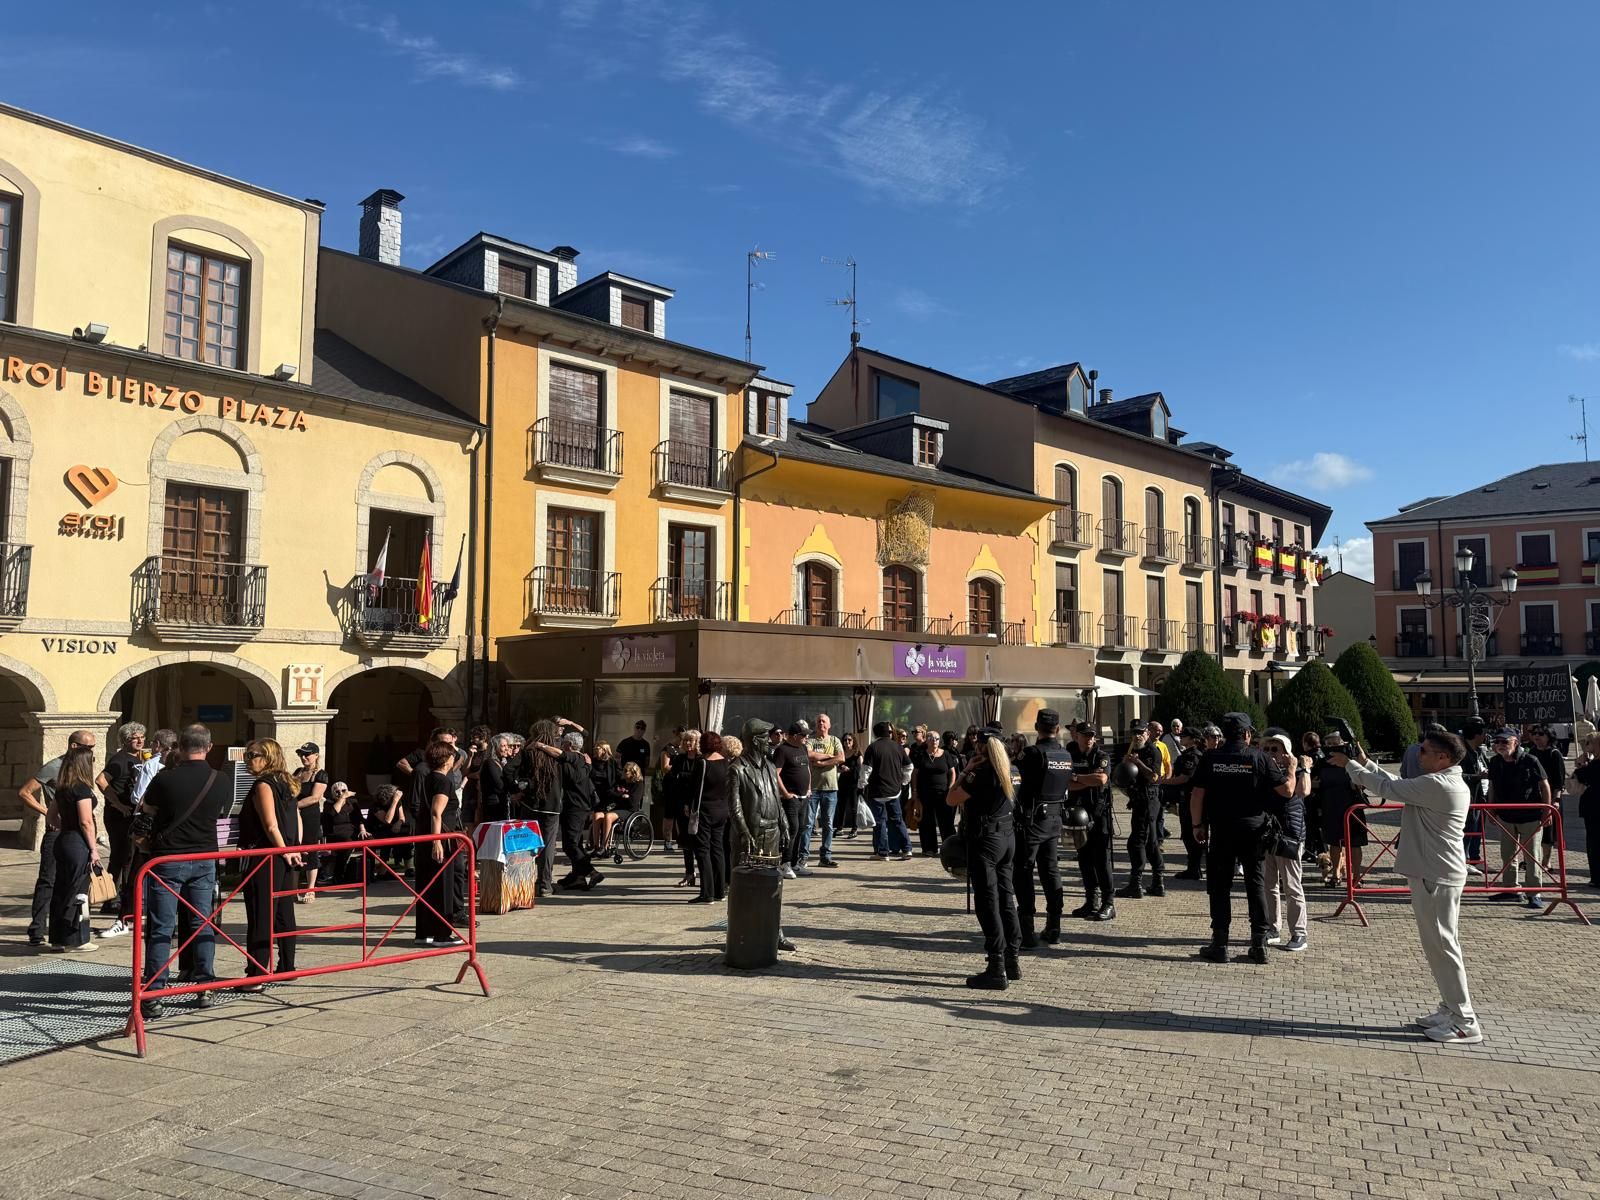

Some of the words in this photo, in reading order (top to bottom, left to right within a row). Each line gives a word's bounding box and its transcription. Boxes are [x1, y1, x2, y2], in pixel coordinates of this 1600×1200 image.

[87, 371, 205, 412] BIERZO
[221, 396, 309, 430] PLAZA
[42, 638, 118, 655] VISION
[292, 676, 320, 702] H
[1506, 674, 1519, 689] NO
[1518, 707, 1528, 720] DE
[1533, 705, 1557, 720] VIDAS
